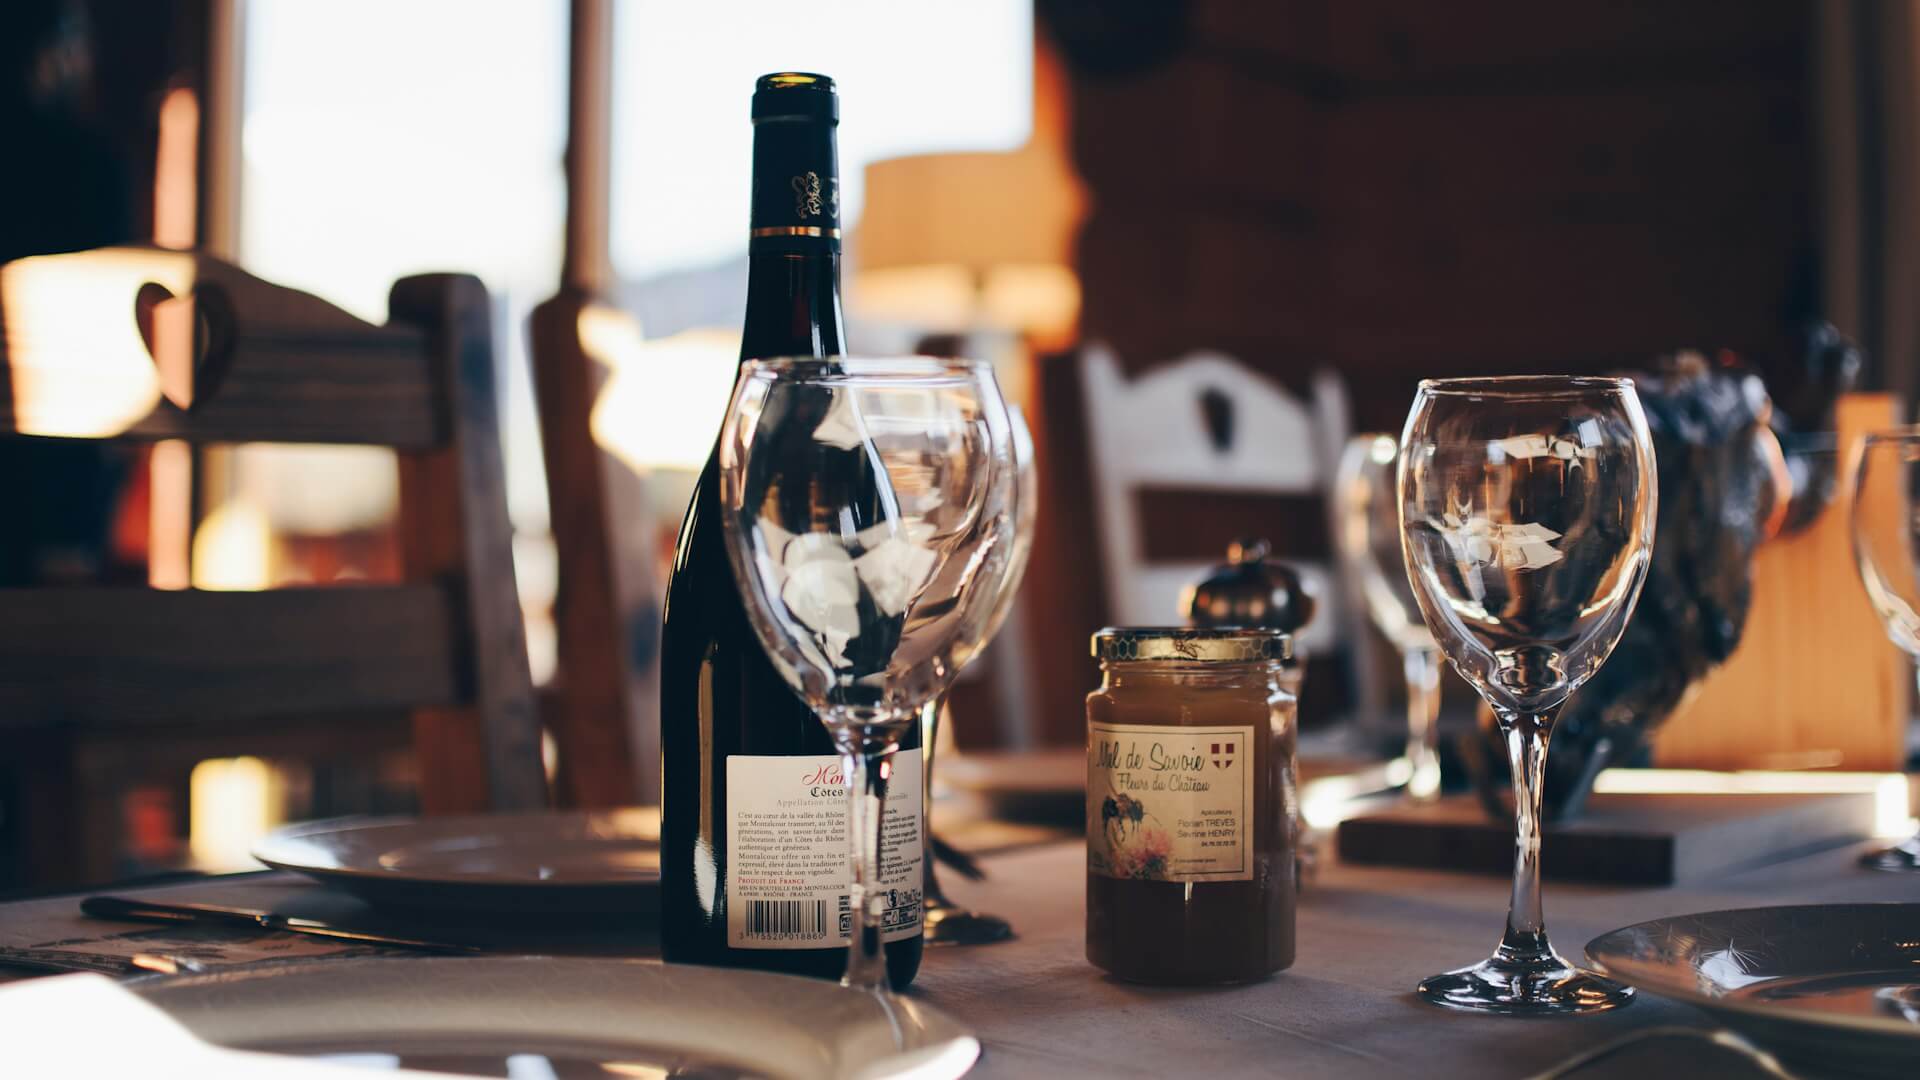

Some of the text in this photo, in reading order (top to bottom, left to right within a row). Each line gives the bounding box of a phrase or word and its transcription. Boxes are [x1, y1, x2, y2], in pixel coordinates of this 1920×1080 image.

[1126, 742, 1144, 769] de
[1149, 743, 1205, 771] Savoie
[1117, 773, 1210, 791] Fleurs du Château
[1207, 829, 1235, 838] HENRY
